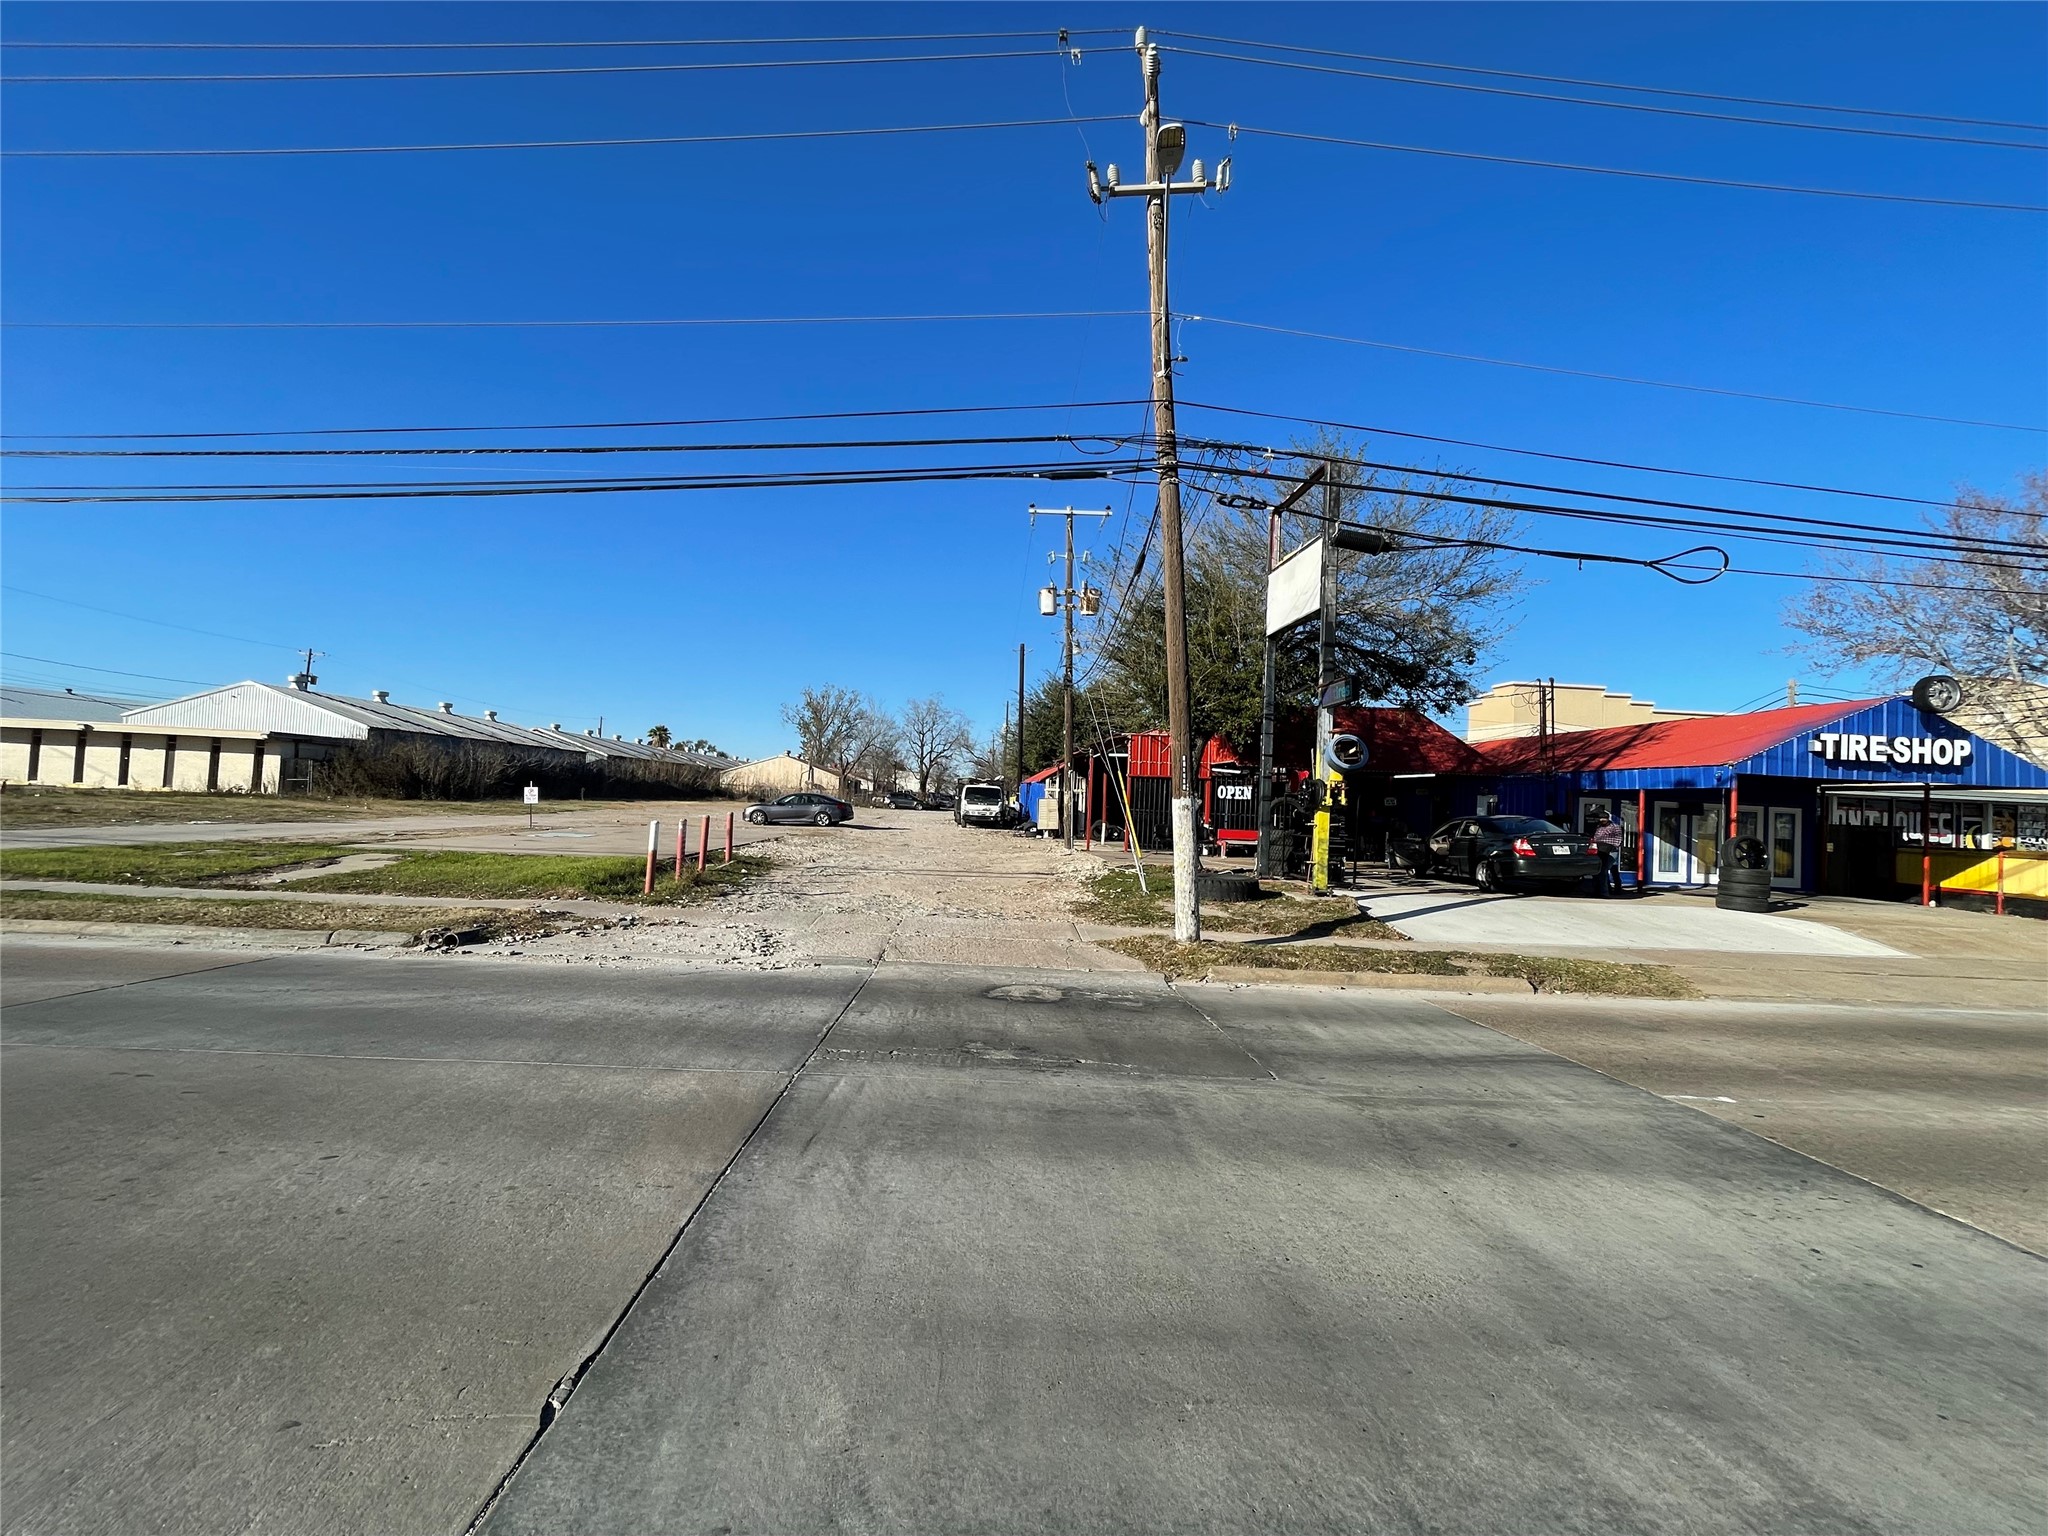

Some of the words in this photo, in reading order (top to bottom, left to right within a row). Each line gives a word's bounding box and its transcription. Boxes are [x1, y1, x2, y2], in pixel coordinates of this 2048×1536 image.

[1819, 732, 1888, 762] TIRE
[1892, 736, 1972, 766] SHOP
[1217, 785, 1252, 800] OPEN
